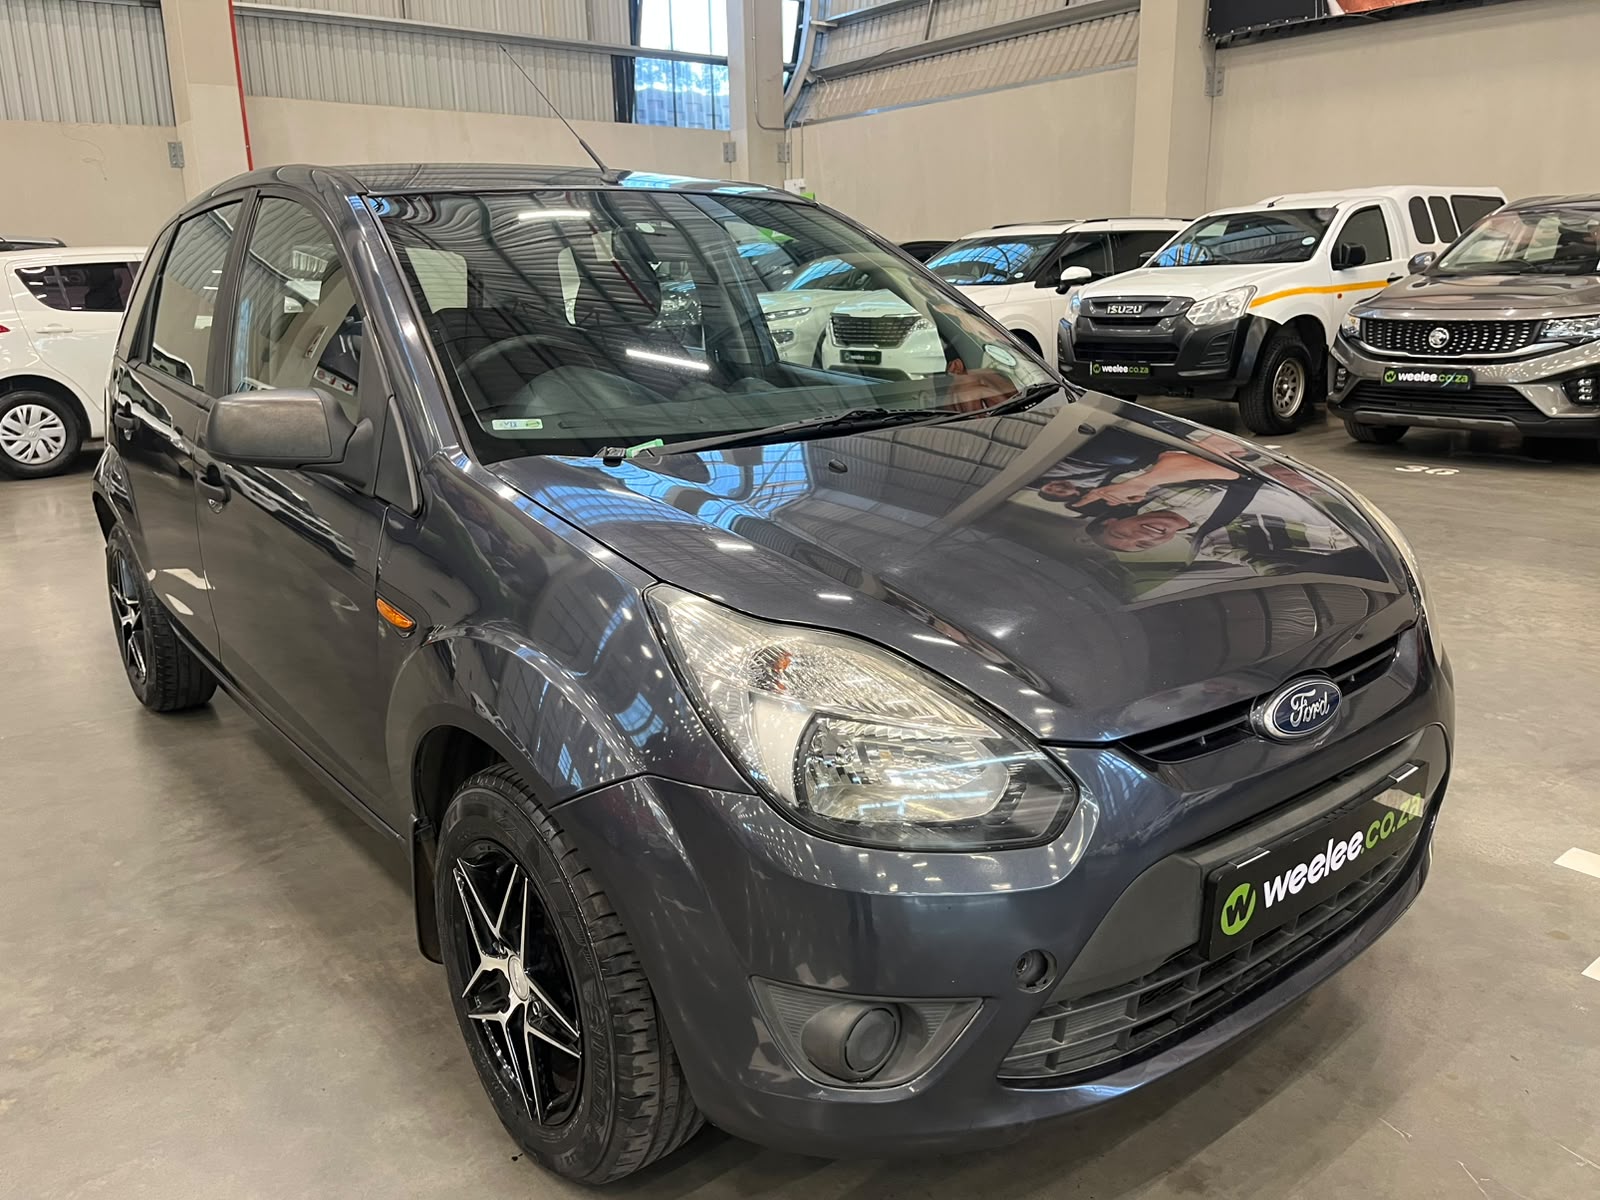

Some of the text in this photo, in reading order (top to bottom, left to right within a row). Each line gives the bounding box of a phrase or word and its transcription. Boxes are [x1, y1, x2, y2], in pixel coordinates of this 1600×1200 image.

[1106, 305, 1142, 314] ISUZU
[1101, 364, 1149, 374] weeleeco.za
[1289, 688, 1330, 728] Ford
[1263, 793, 1422, 908] weelee.co.za
